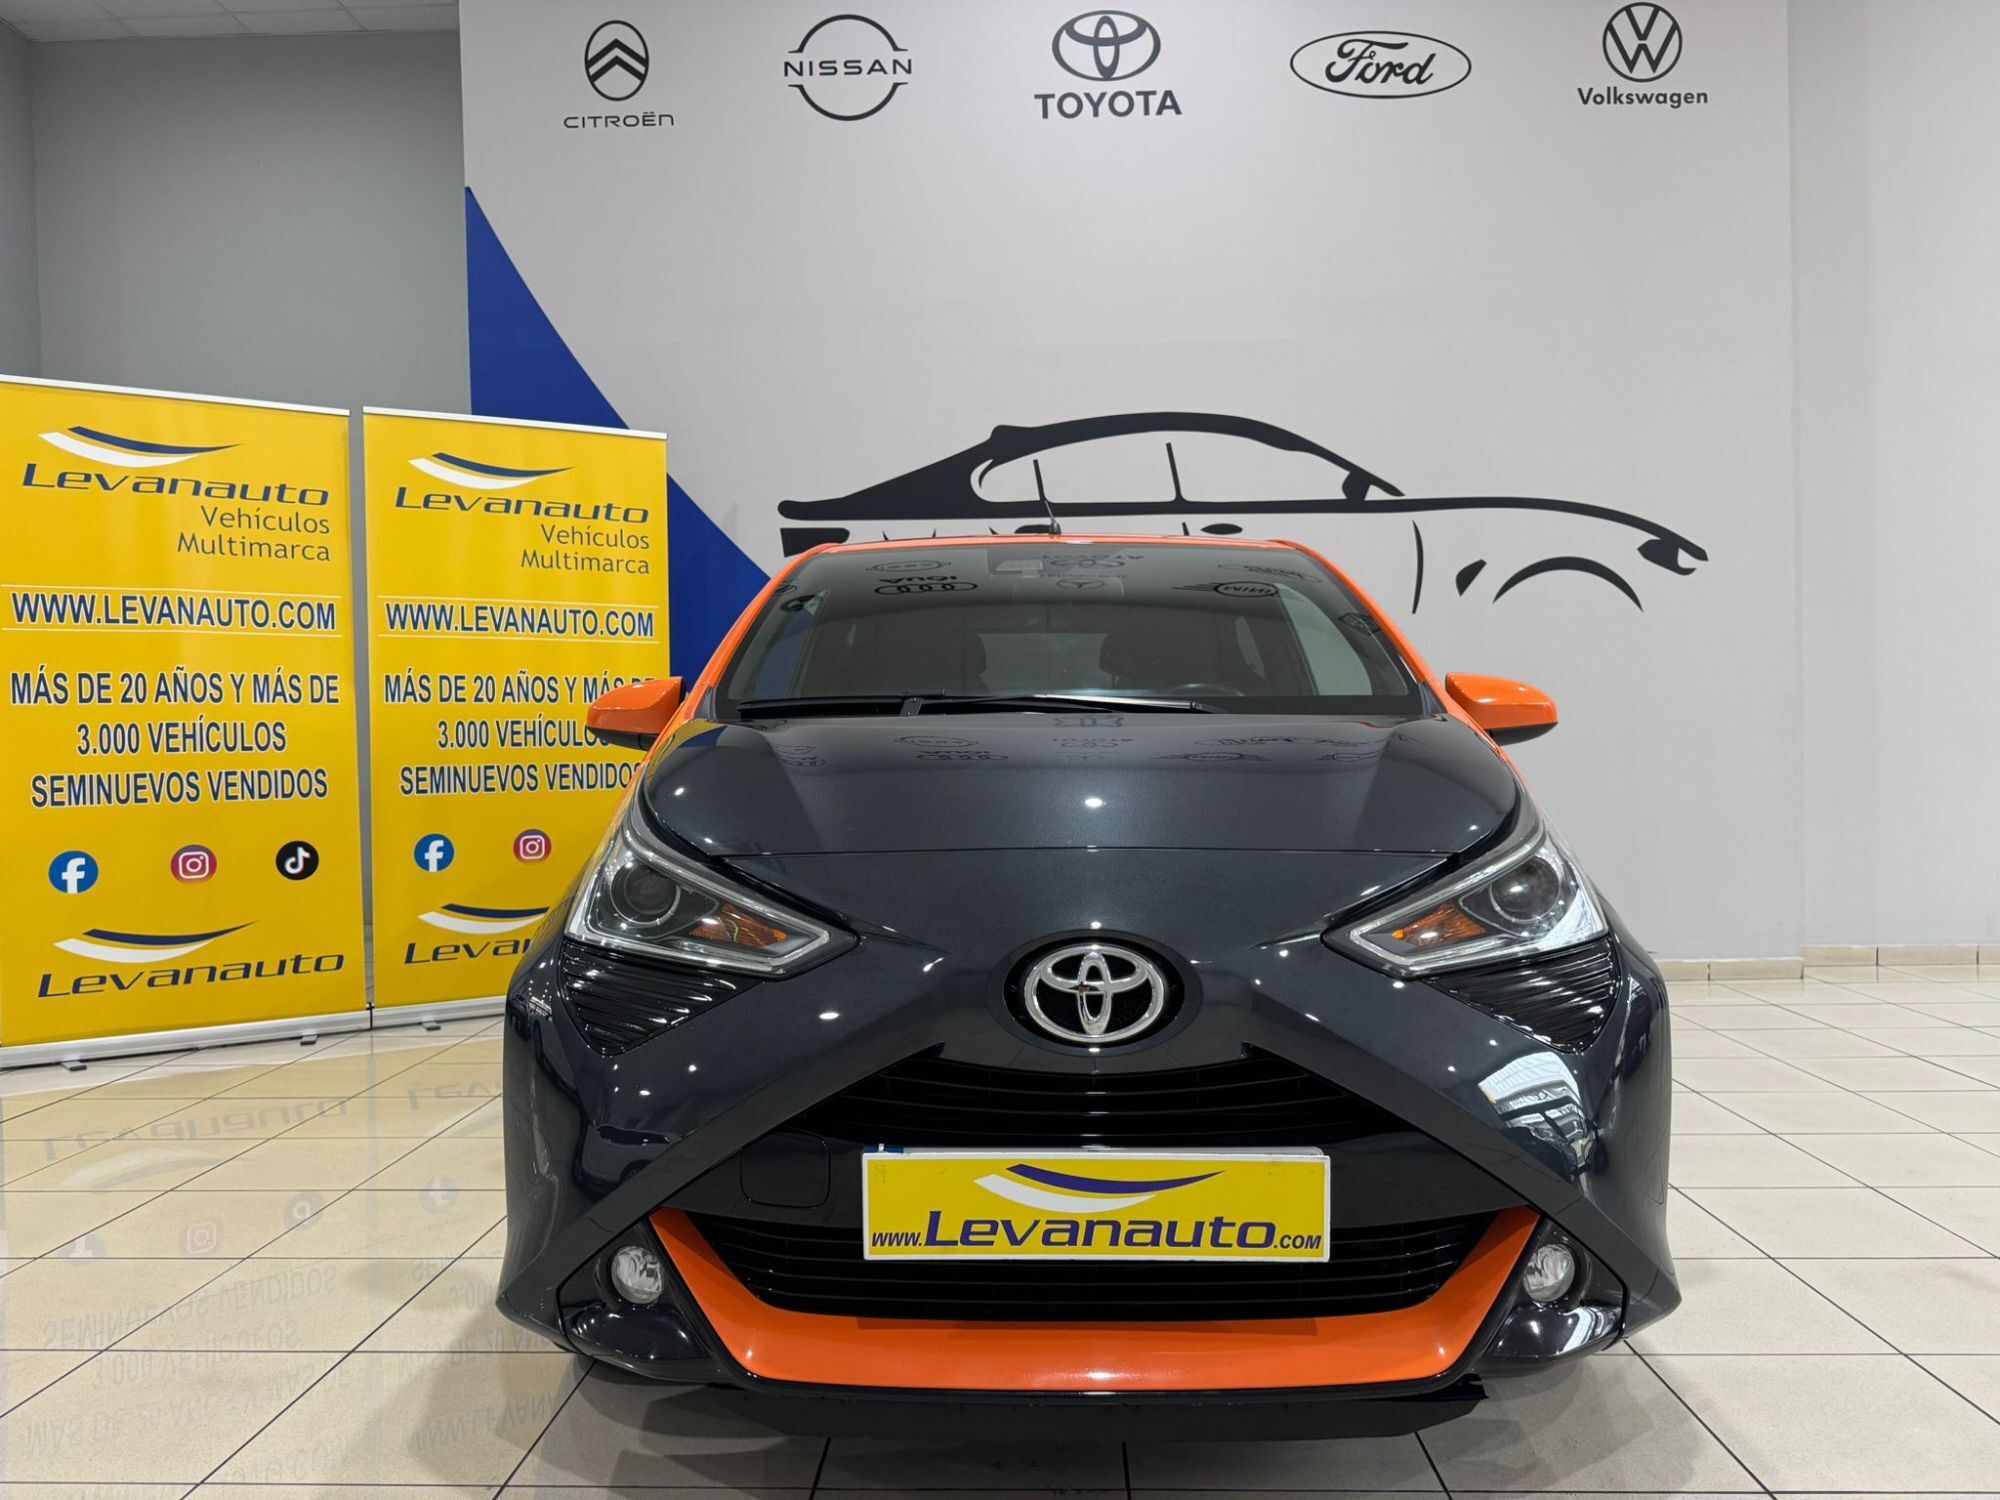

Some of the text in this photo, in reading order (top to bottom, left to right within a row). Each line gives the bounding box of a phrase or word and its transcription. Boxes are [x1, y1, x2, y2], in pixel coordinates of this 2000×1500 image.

[784, 58, 912, 77] NISSAN
[1325, 38, 1436, 85] Ford
[1034, 89, 1182, 120] TOYOTA
[1577, 87, 1709, 109] Volkswagen
[22, 463, 329, 506] Levanauto
[201, 505, 330, 534] Vehículos
[395, 486, 649, 524] Levanauto
[177, 532, 330, 562] Multimarca
[541, 524, 650, 549] Vehículos
[521, 549, 650, 574] Multimarca
[12, 592, 336, 630] WWW.LEVANAUTO.COM
[386, 603, 654, 637] WWW.LEVANAUTO.COM
[11, 665, 340, 704] MÁS DE 20 AÑOS Y MÁS DE
[385, 668, 432, 703] MÁS
[439, 675, 467, 703] DE
[473, 674, 496, 703] 20
[502, 670, 559, 703] AÑOS
[565, 676, 578, 703] Y
[77, 715, 287, 755] 3.000 VEHÍCULOS
[438, 714, 610, 748] 3.000 VEHÍCULO
[31, 768, 328, 807] SEMINUEVOS VENDIDOS
[400, 762, 642, 795] SEMINUEVOS VENDIDO
[37, 949, 345, 999] Levanauto
